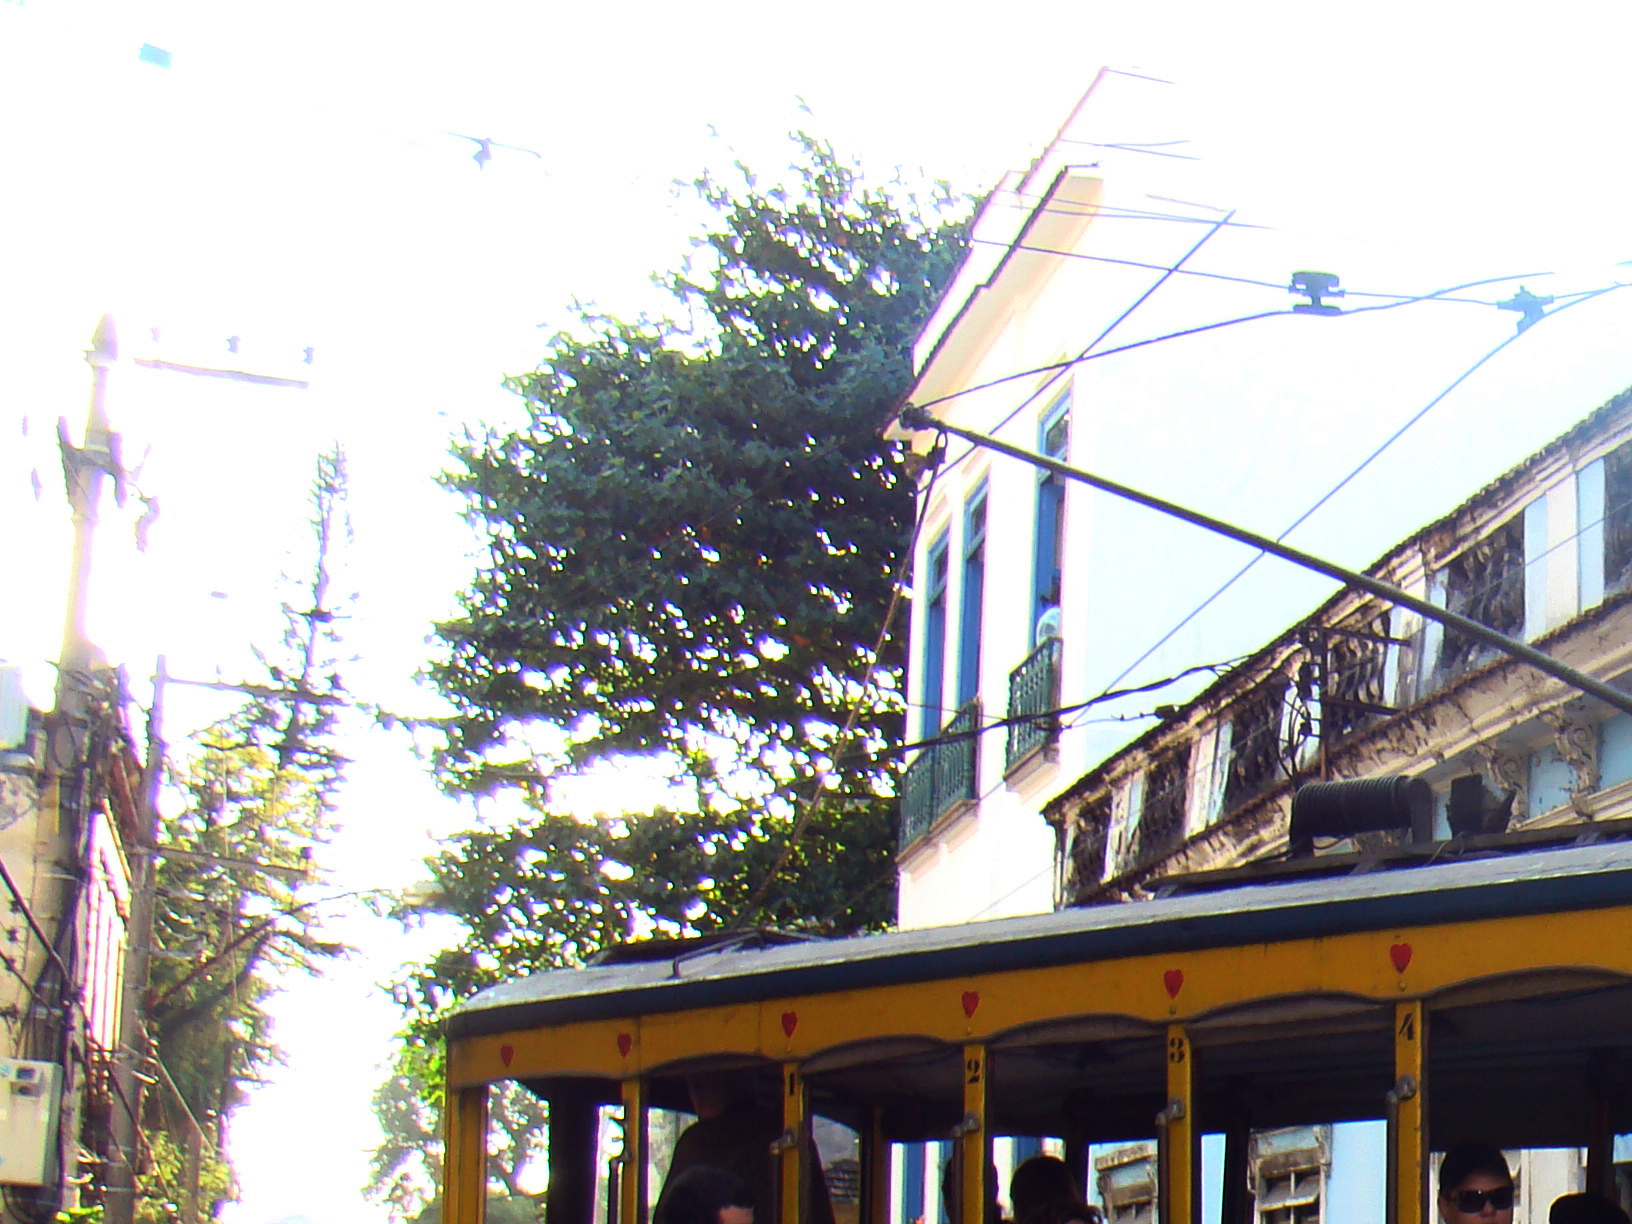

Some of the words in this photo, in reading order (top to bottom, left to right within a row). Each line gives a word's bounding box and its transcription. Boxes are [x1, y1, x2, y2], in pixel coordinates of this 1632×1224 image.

[1398, 1012, 1415, 1042] 4
[1169, 1036, 1185, 1064] 3
[788, 1072, 796, 1096] 1
[966, 1058, 981, 1085] 2
